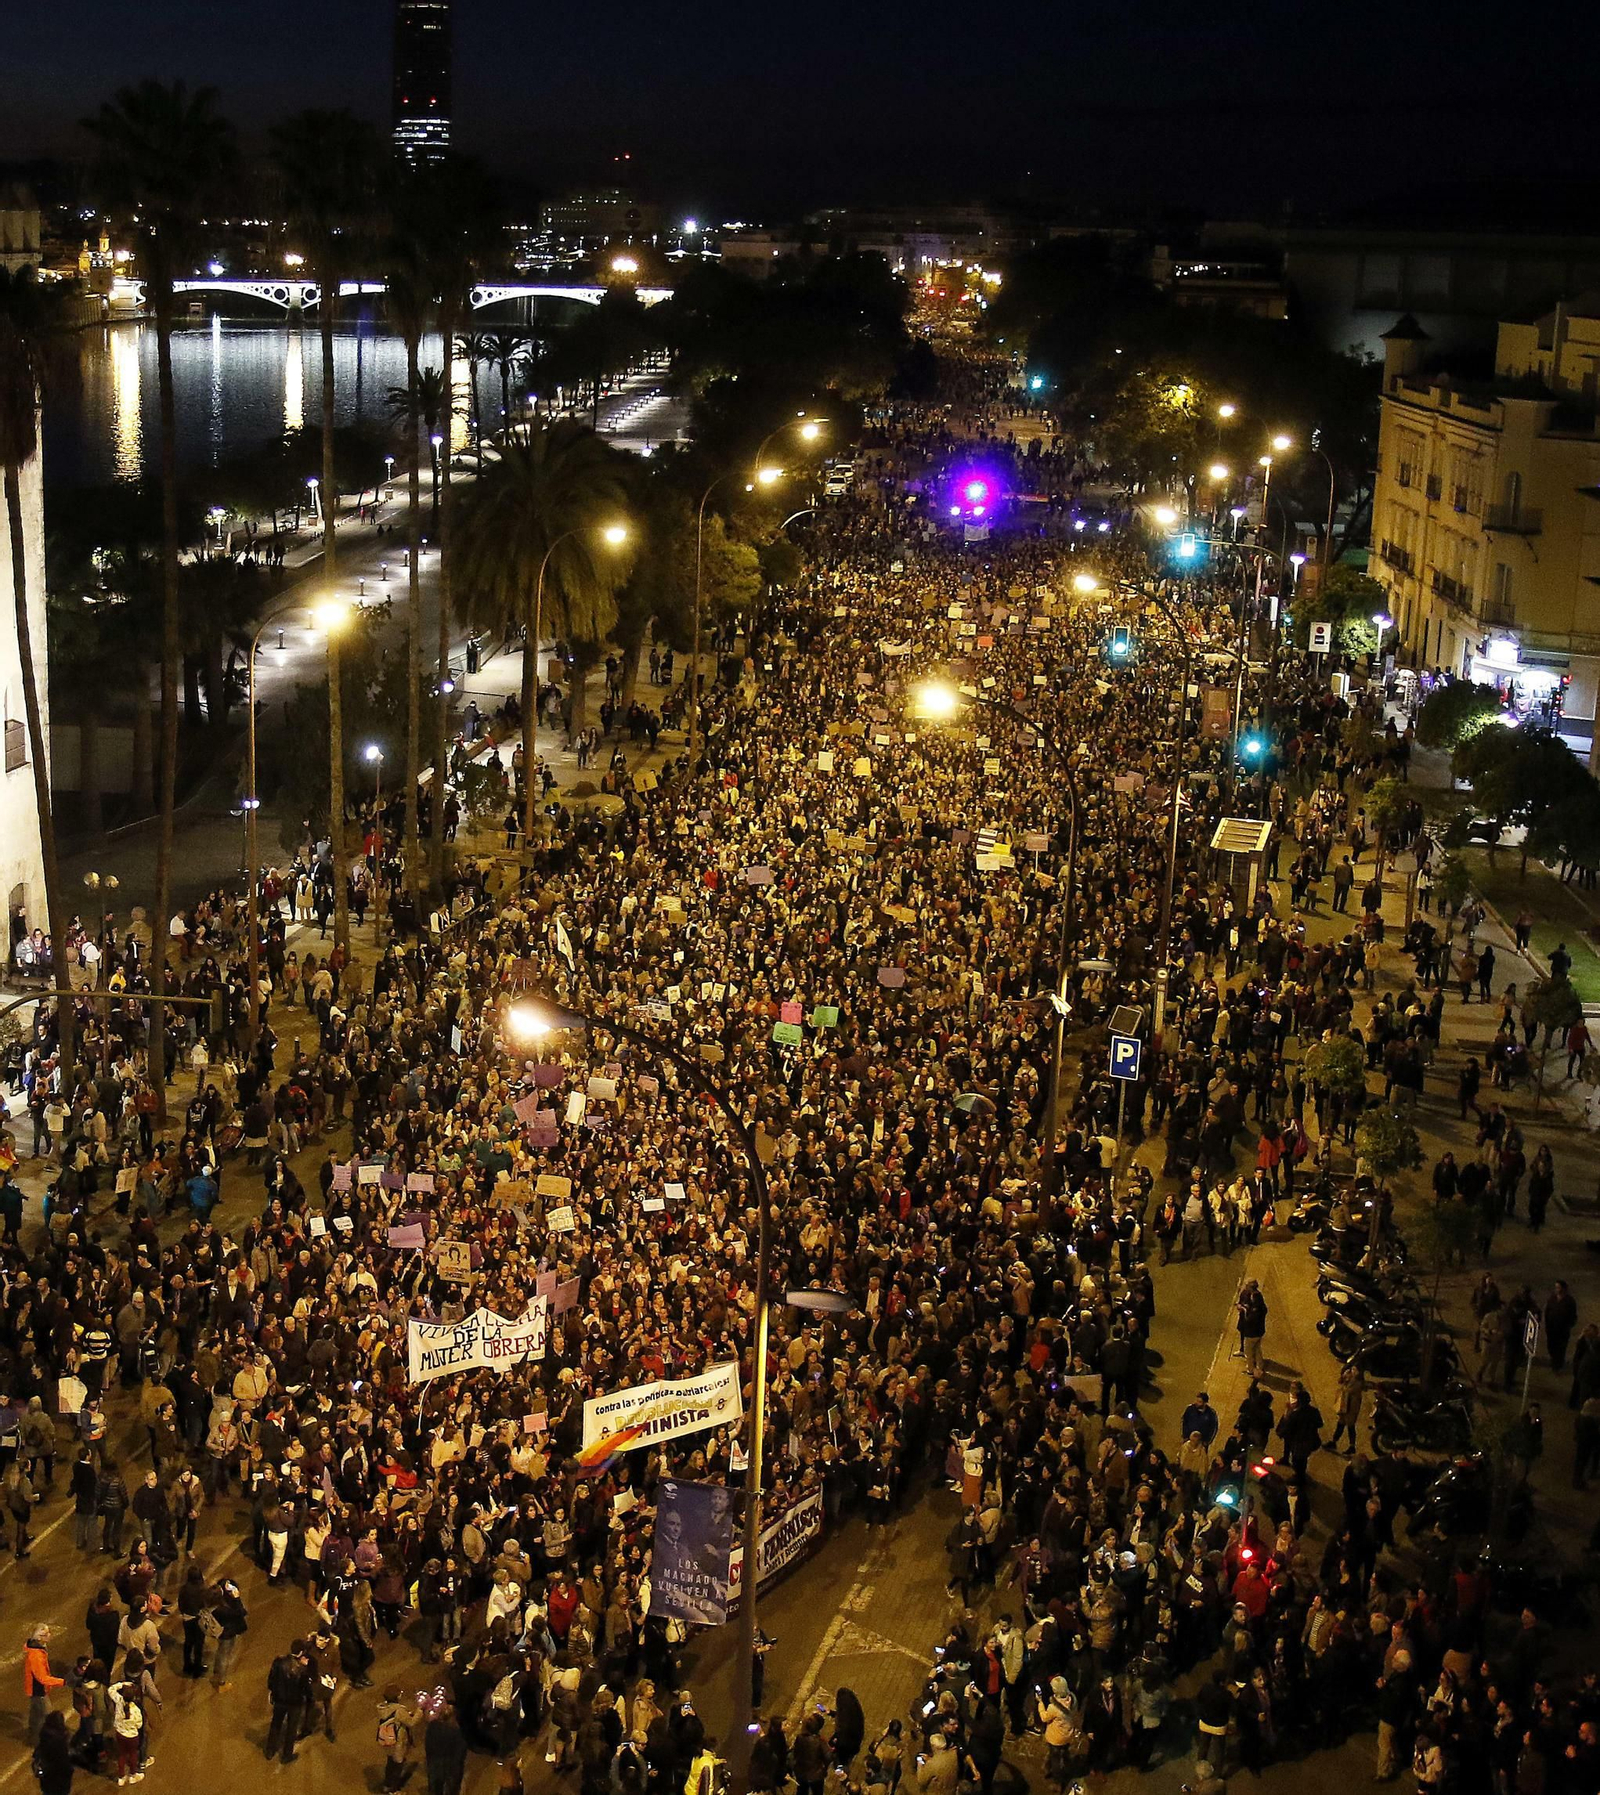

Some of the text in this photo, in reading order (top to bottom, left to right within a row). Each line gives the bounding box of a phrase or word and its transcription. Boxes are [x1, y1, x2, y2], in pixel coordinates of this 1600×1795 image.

[1116, 1042, 1135, 1063] P
[419, 1324, 457, 1339] VIV
[453, 1326, 502, 1347] DE LA
[420, 1331, 546, 1372] MUJER OBRERA
[614, 1408, 710, 1438] MINISTA
[678, 1558, 700, 1571] LOS
[663, 1567, 719, 1586] MACHADO
[657, 1580, 710, 1598] VUELVEN
[664, 1594, 713, 1612] SEVILLA
